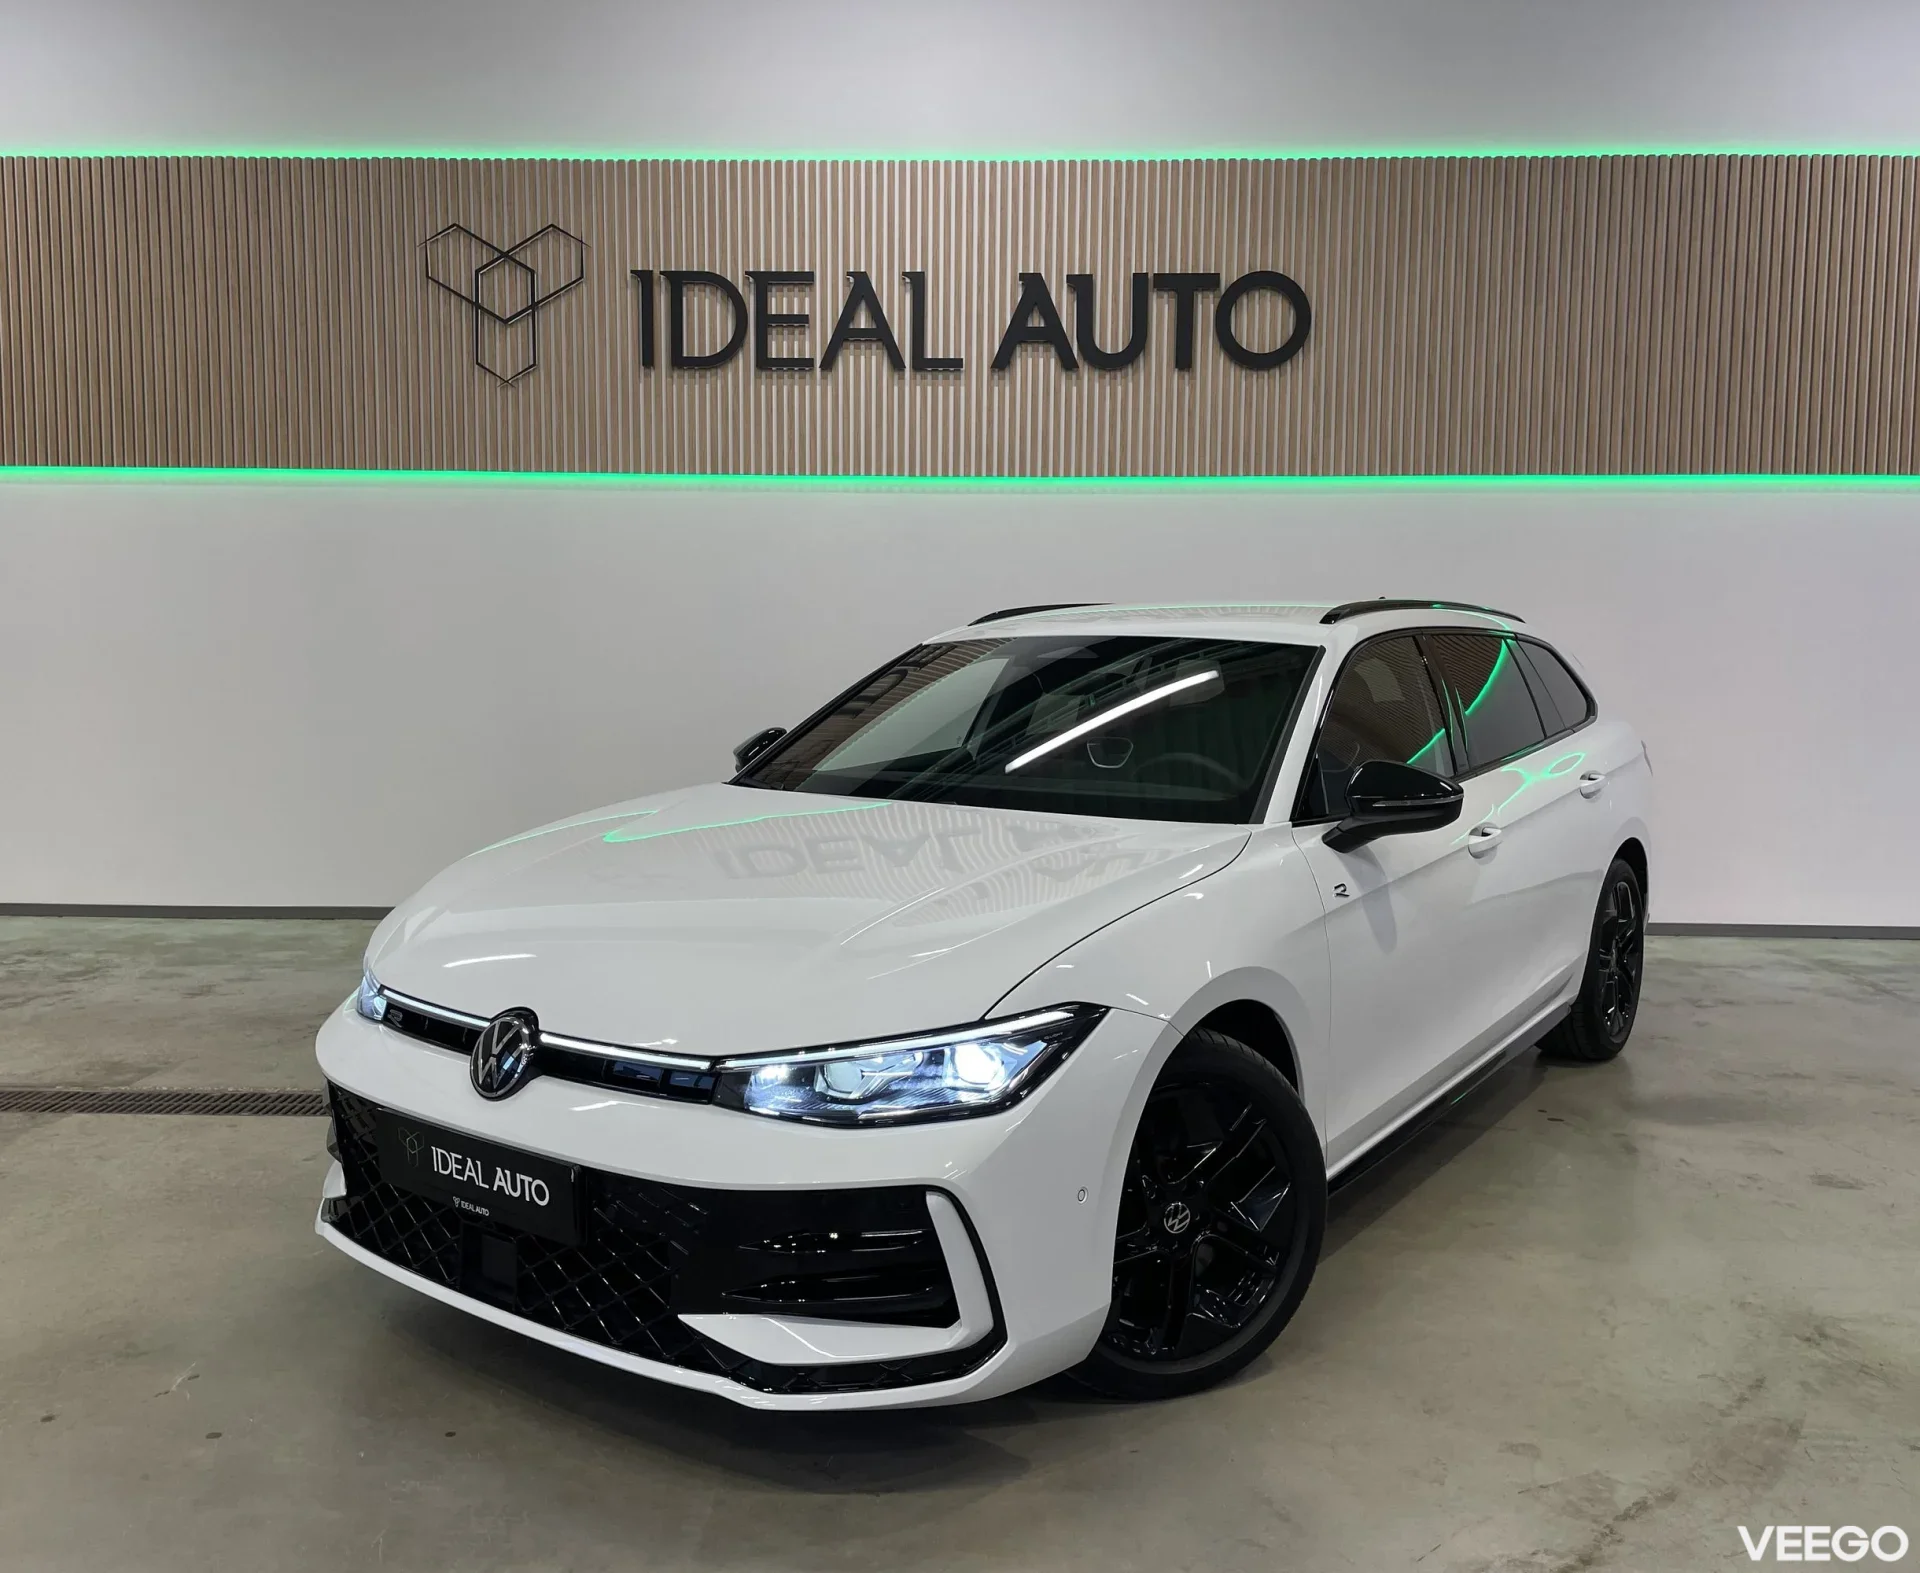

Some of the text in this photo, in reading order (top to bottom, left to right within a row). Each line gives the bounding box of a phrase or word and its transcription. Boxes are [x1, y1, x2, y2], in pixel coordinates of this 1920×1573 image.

[630, 270, 1312, 372] IDEAL AUTO
[431, 1146, 550, 1206] IDEAL AUTO
